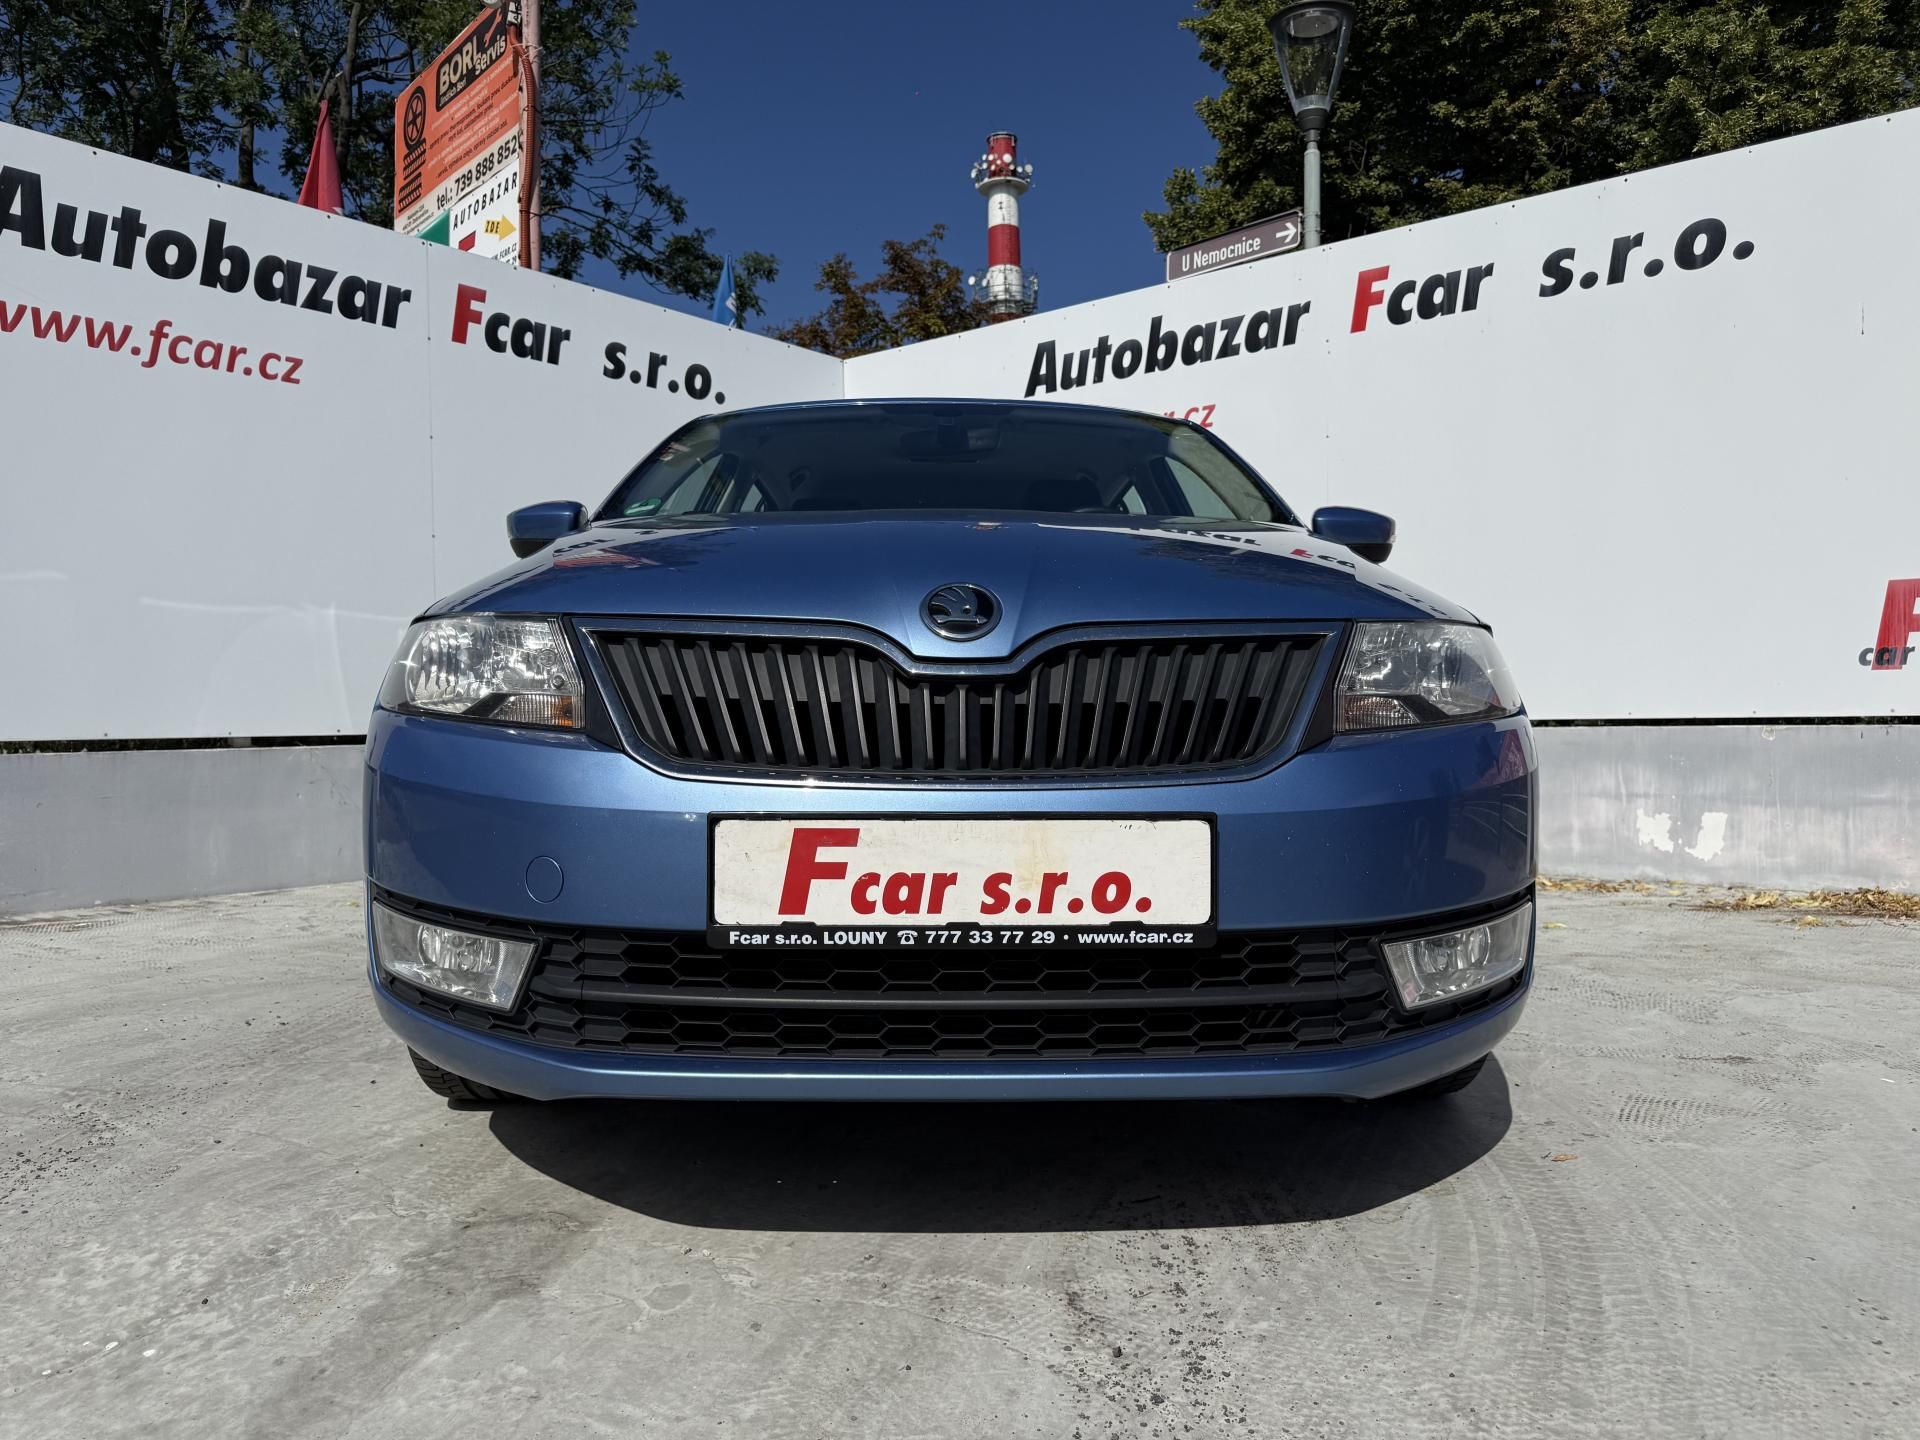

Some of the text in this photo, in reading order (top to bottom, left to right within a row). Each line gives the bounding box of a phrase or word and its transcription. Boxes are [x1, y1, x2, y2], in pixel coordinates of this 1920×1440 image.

[475, 34, 506, 75] servis
[454, 167, 473, 197] 739
[475, 152, 495, 181] 888
[497, 134, 517, 166] 852
[453, 171, 518, 231] AUTOBAZAR
[485, 220, 500, 233] ZDE
[1182, 236, 1261, 272] U Nemocnice
[0, 165, 726, 405] Autobazar Fcar s.r.o.
[1024, 217, 1755, 397] Autobazar Fcar s.r.o.
[778, 827, 1152, 916] Fcar s.r.o.
[729, 931, 1194, 945] Fcar s.r.o. LOUNY 777 33 77 29 www.fcar.cz
